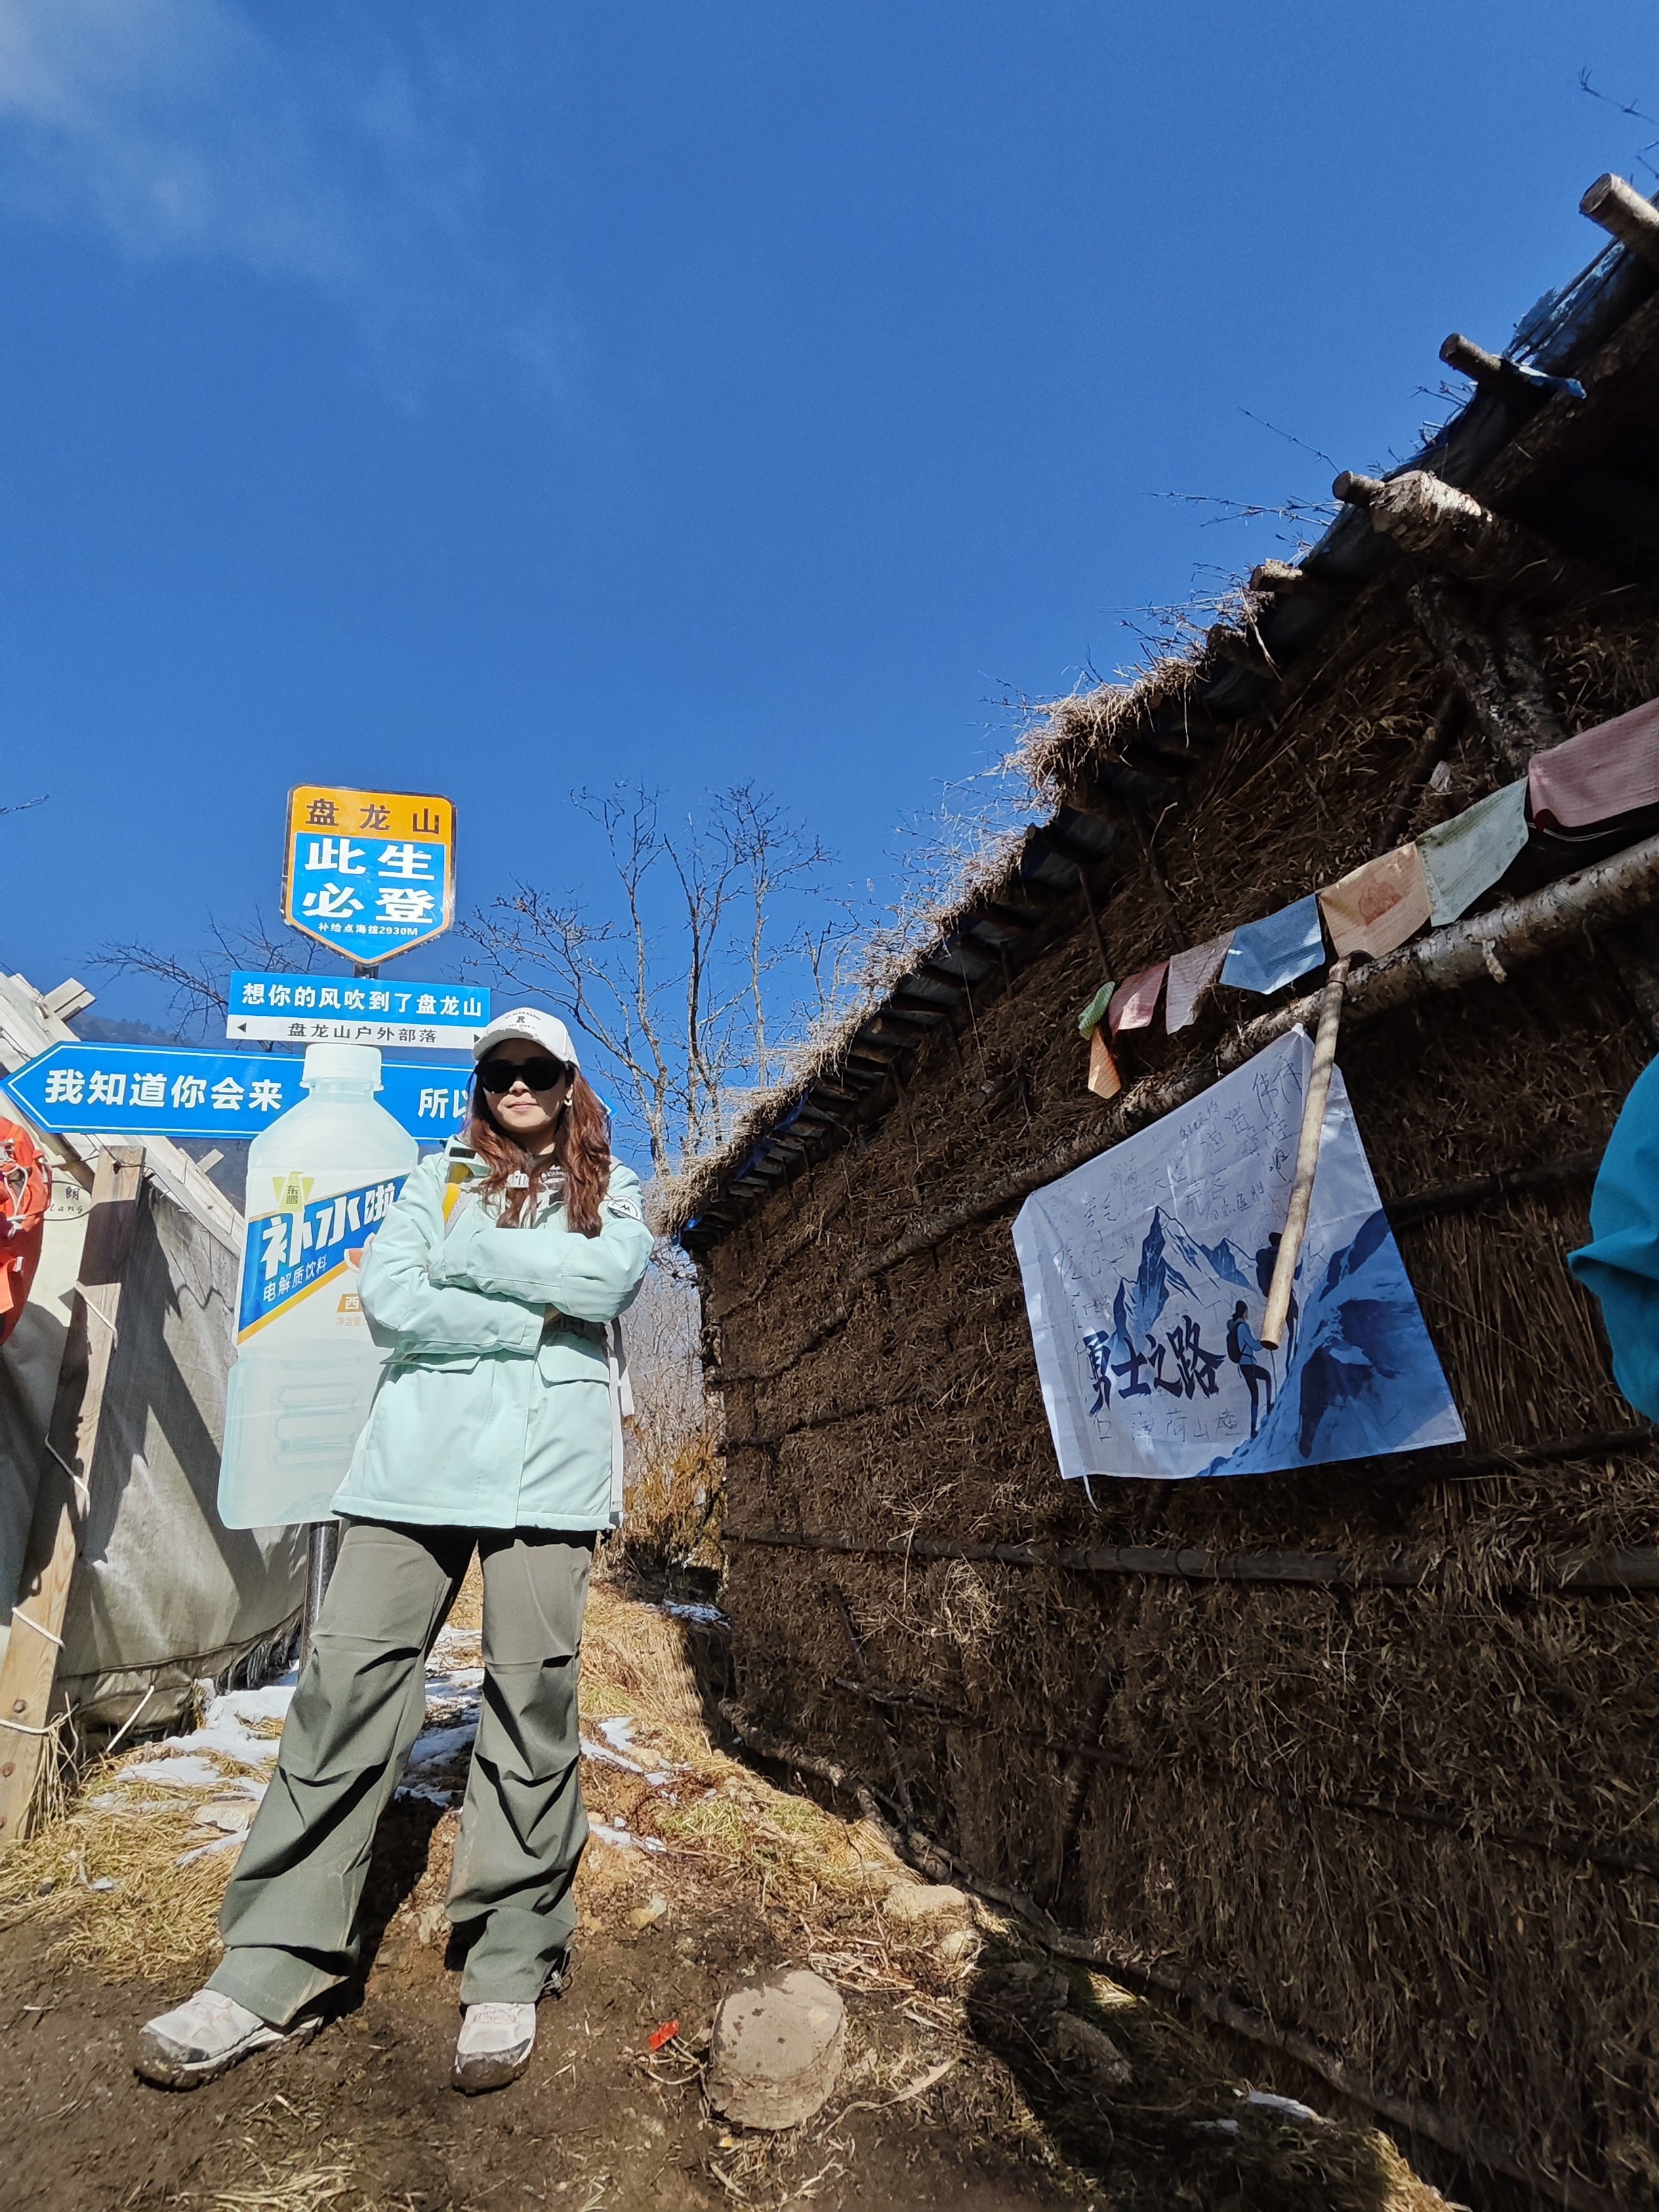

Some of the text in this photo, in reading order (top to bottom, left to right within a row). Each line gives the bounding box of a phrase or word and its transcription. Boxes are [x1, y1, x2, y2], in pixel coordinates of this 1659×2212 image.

[305, 798, 440, 834] 盘龙山
[304, 838, 434, 880] 此生
[302, 882, 435, 924] 必登
[318, 922, 418, 936] 补给点海拔2930M
[242, 982, 482, 1017] 想你的风吹到了盘龙山
[287, 1022, 437, 1044] 盘龙山户外部落
[45, 1069, 283, 1111] 我知道你会来
[50, 1204, 83, 1214] lang
[65, 1186, 81, 1201] 朗
[286, 1185, 300, 1204] 东鹏
[260, 1182, 396, 1281] 补水啦
[263, 1254, 327, 1303] 电解质饮料
[344, 1296, 360, 1311] 西
[1082, 1315, 1226, 1418] 勇士之路
